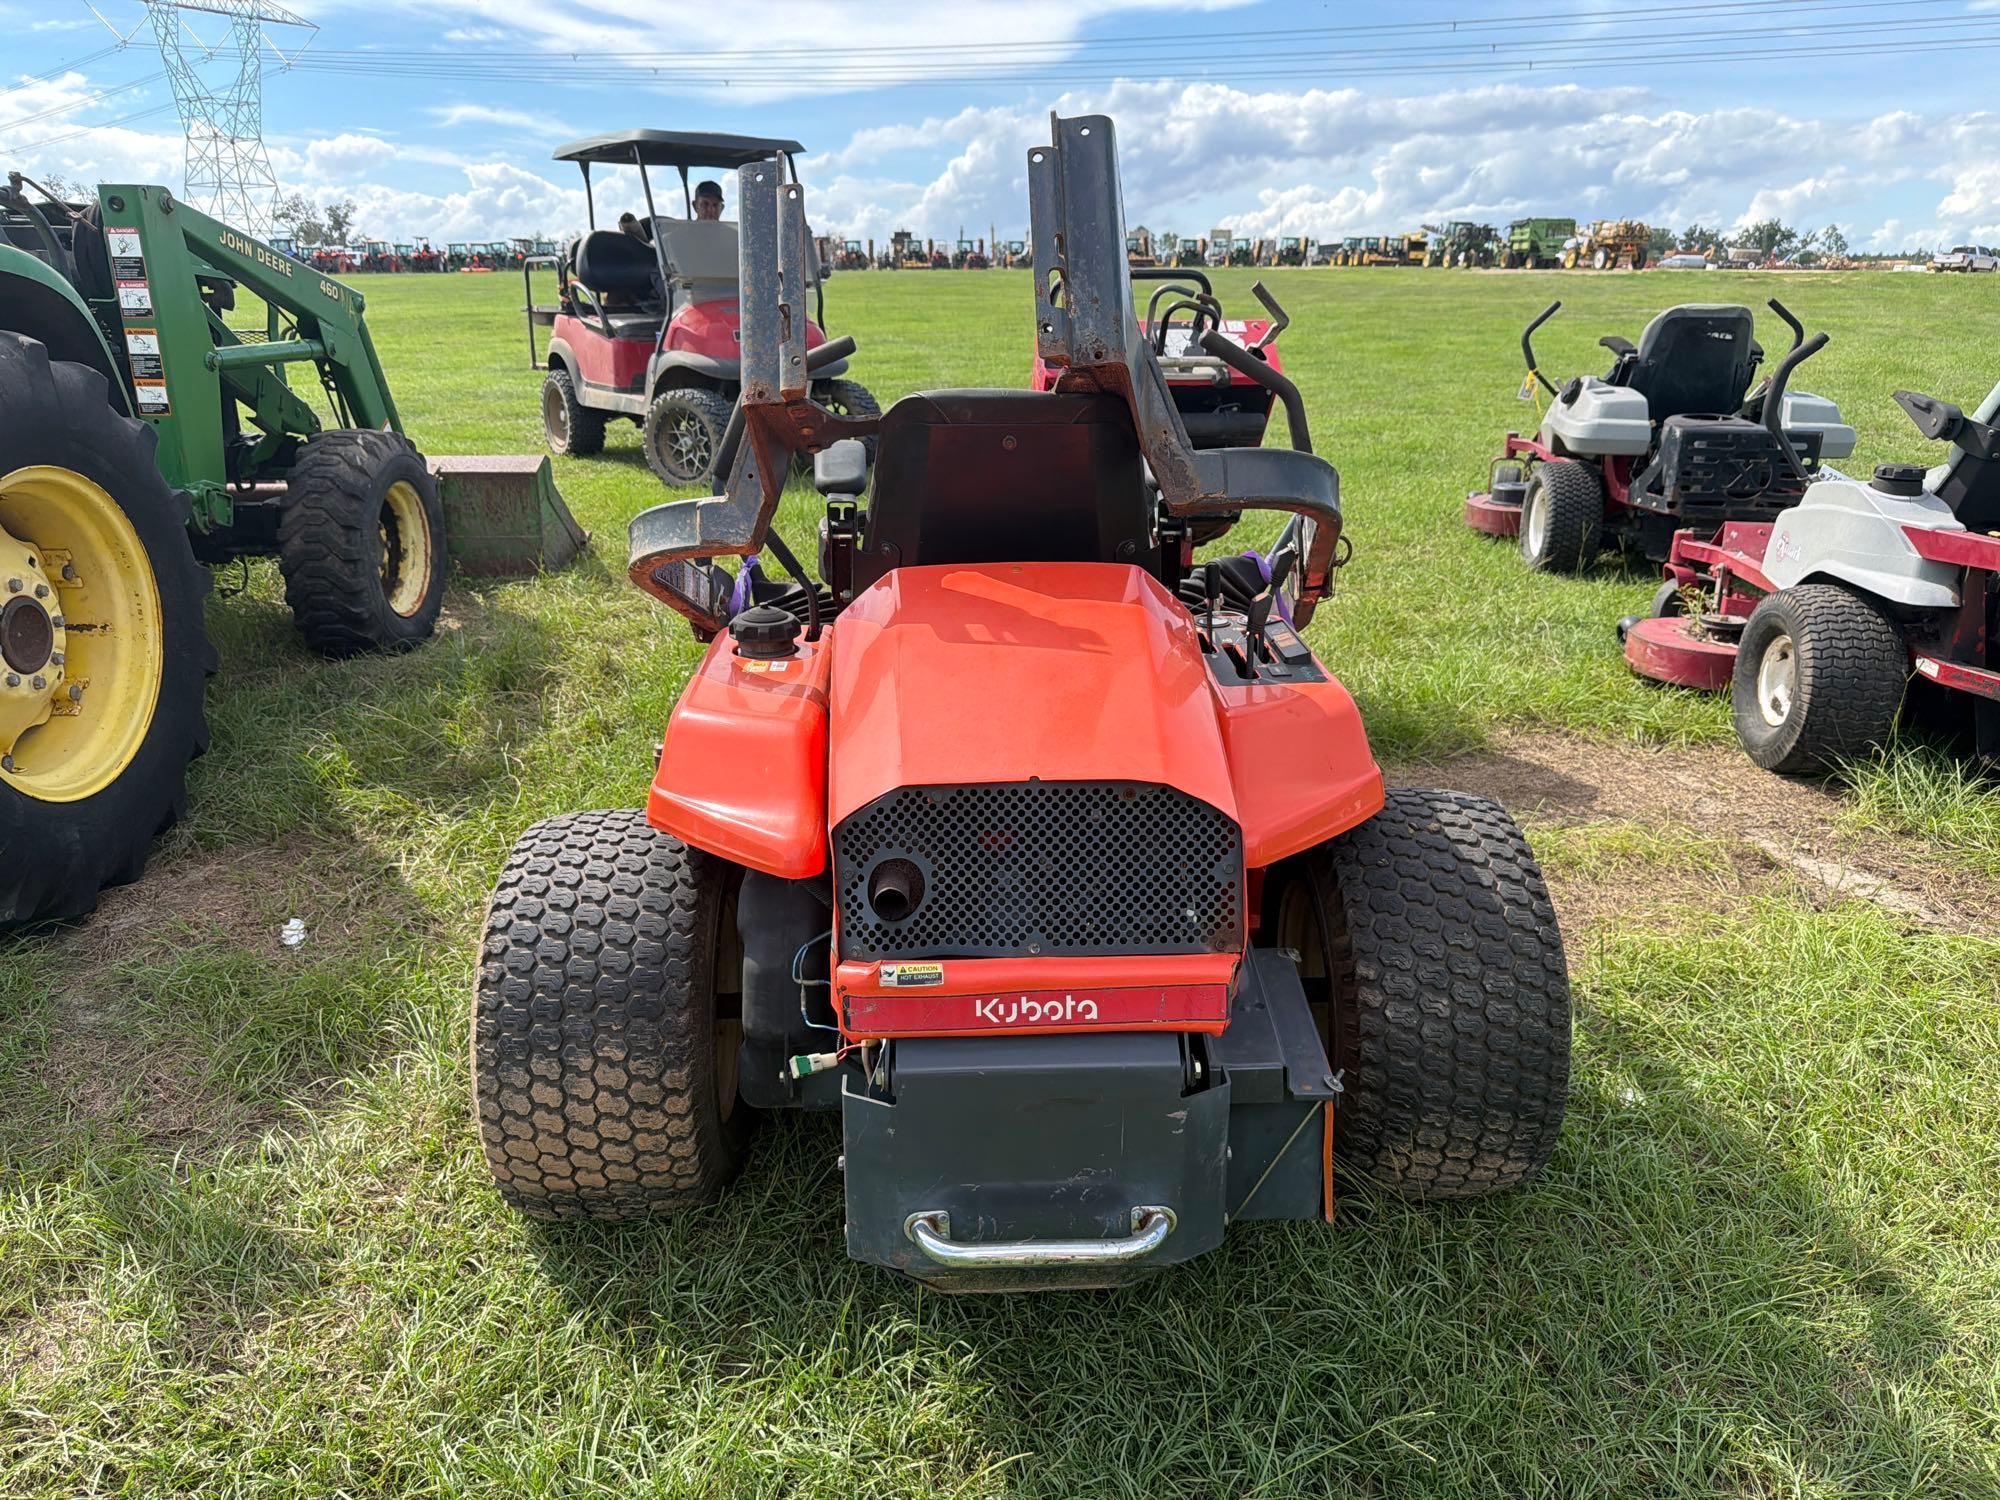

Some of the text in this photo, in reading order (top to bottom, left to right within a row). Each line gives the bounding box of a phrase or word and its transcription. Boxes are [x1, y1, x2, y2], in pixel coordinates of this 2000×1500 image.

[219, 230, 293, 278] JOHN DEERE
[319, 280, 339, 300] 460
[907, 965, 938, 973] CAUTION
[975, 994, 1098, 1023] Kubota
